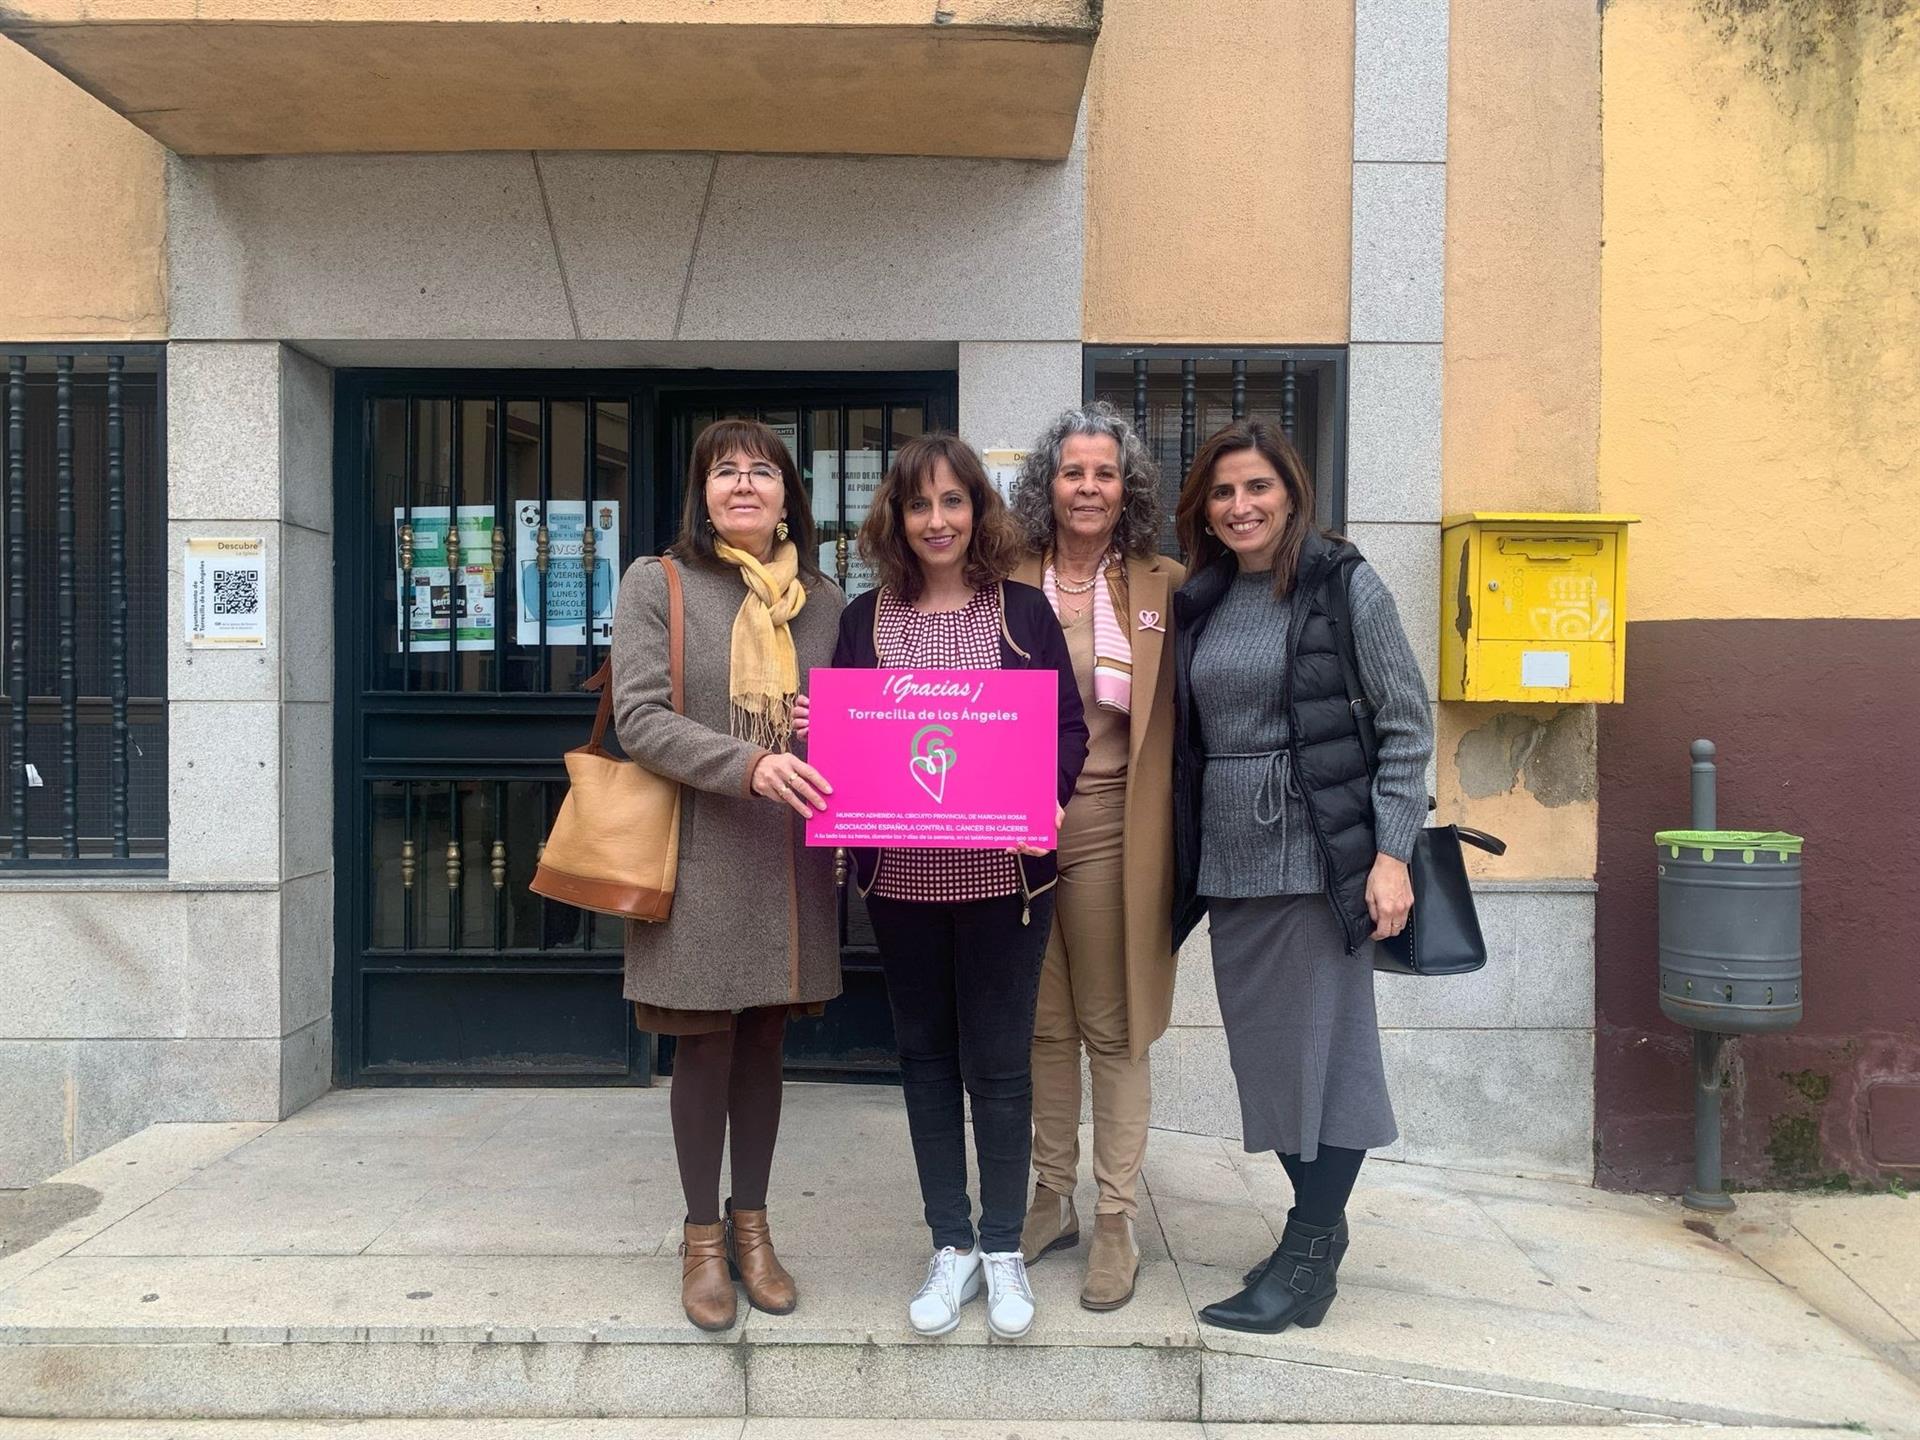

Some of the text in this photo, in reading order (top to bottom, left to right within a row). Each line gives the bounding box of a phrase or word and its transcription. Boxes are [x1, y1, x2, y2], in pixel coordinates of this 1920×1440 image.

[831, 471, 860, 480] HOARIO
[217, 541, 258, 550] Descubre
[847, 707, 1018, 724] Torrecilla de los Ángeles
[834, 822, 877, 830] ASOCIACIÓN
[878, 822, 914, 831] ESPAÑOLA
[955, 823, 984, 832] CÁNCER
[996, 824, 1029, 832] CÁCERES
